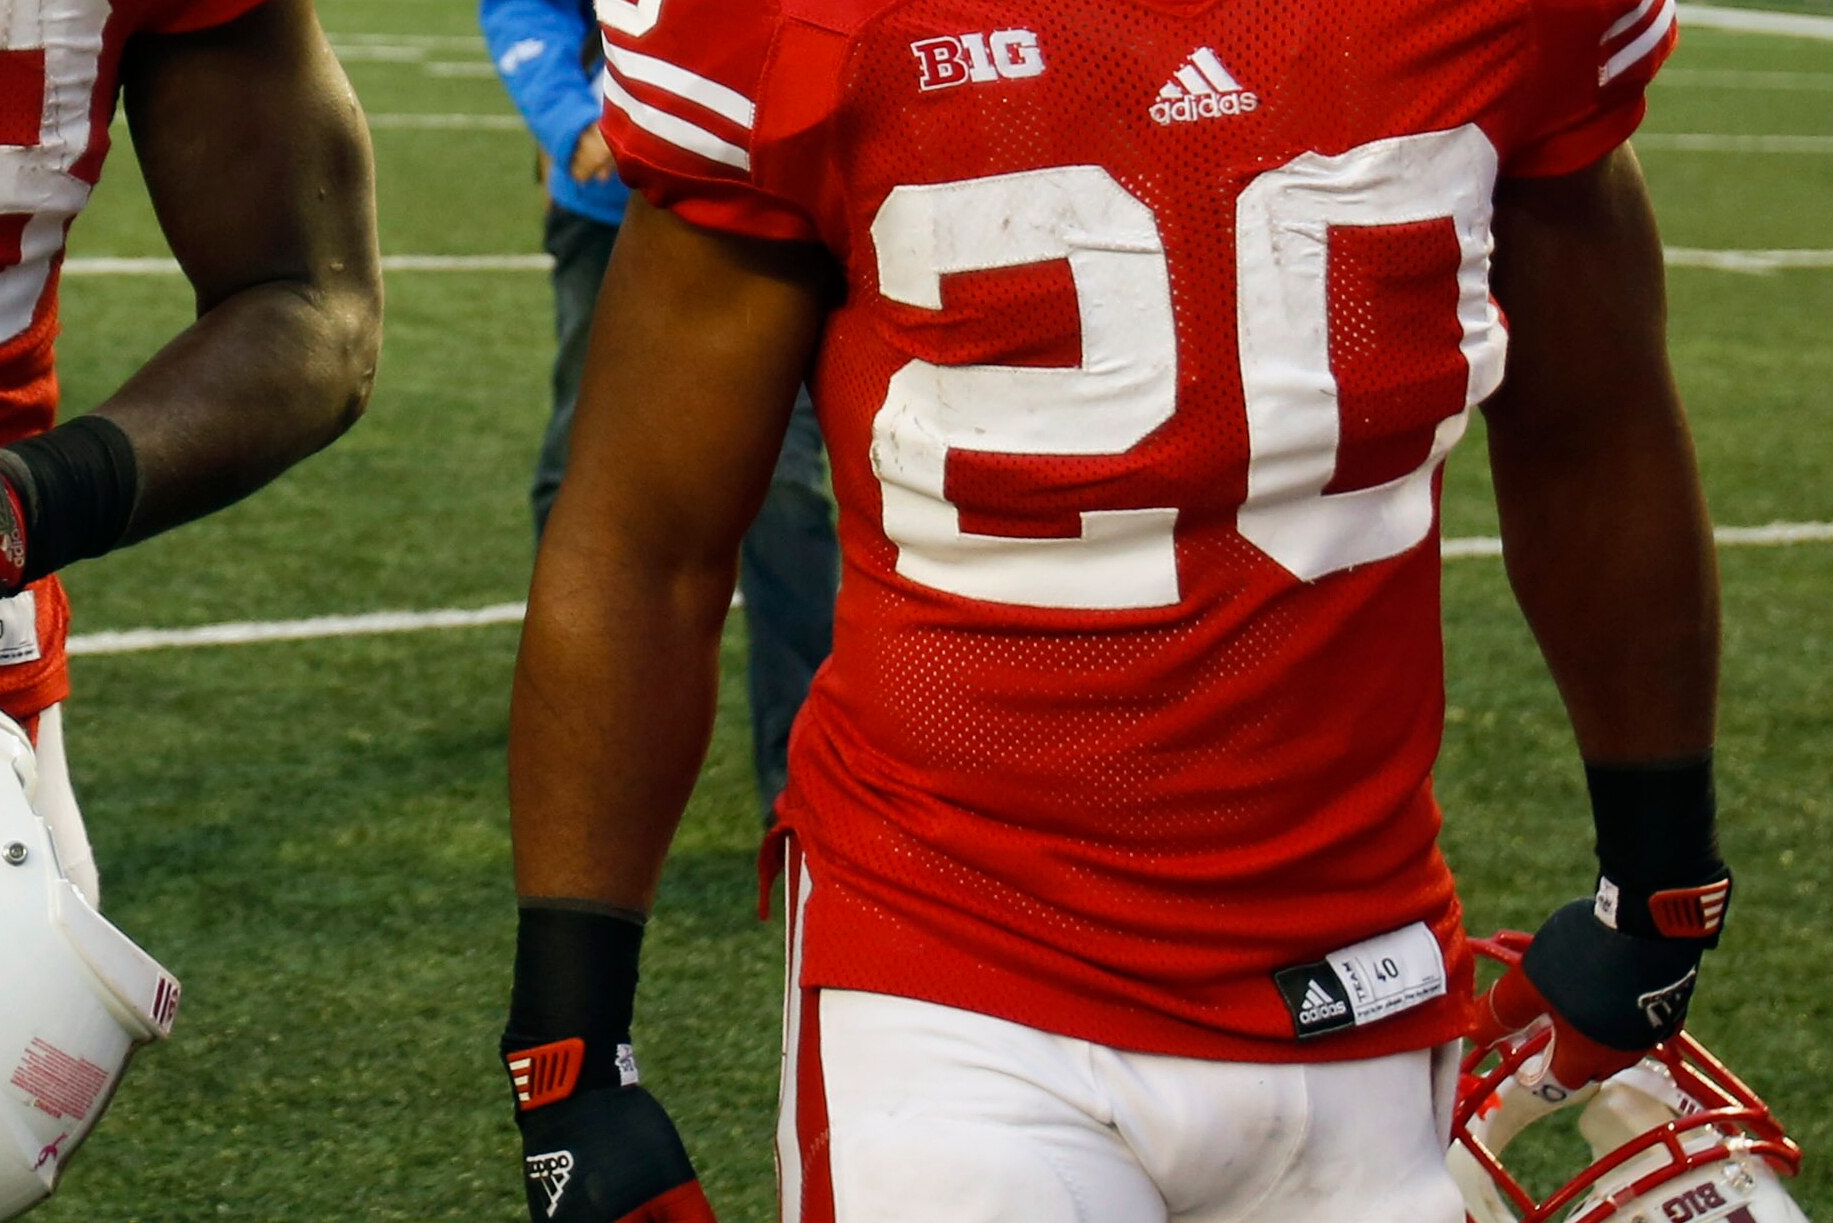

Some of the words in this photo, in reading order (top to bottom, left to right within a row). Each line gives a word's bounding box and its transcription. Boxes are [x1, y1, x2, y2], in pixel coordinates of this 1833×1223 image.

[1147, 87, 1258, 126] adidas
[869, 121, 1509, 610] 20
[1373, 956, 1400, 982] 40
[1298, 1000, 1348, 1025] adidas
